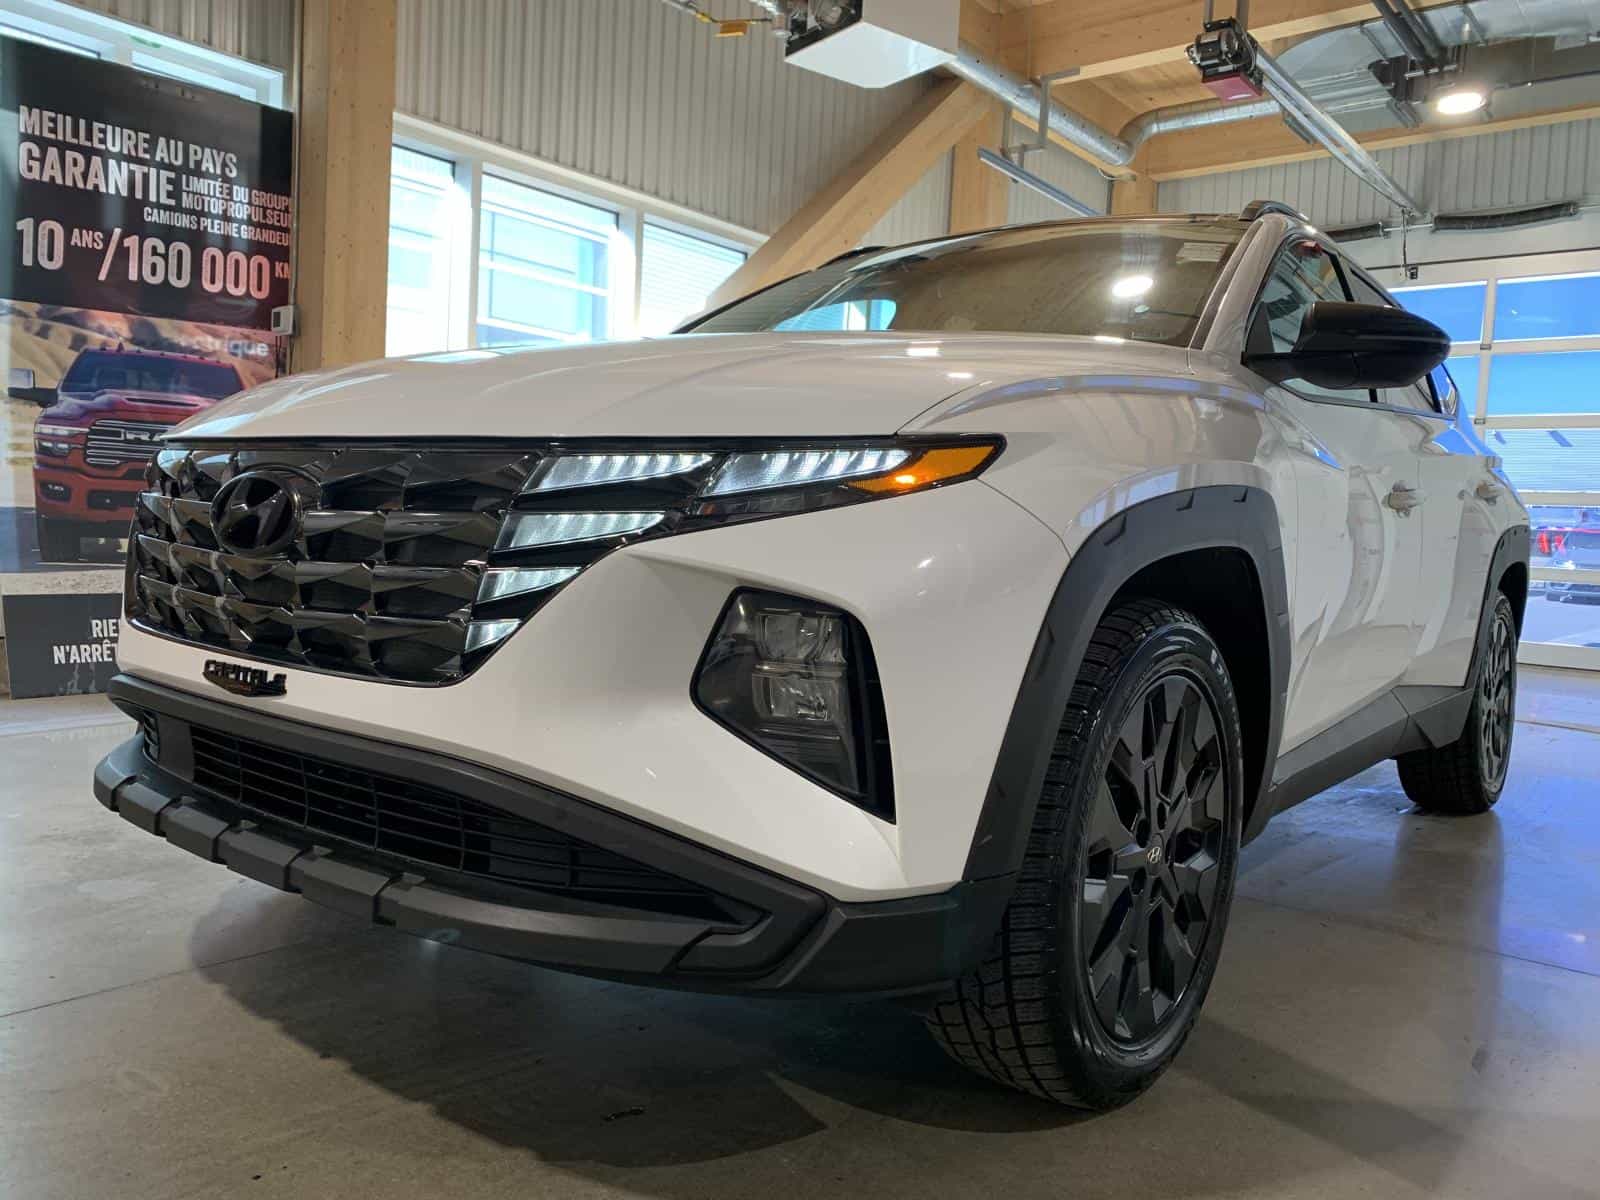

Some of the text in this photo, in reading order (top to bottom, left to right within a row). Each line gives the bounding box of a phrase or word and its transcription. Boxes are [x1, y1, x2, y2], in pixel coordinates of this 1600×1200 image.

[19, 105, 237, 178] MEILLEURE AU PAYS
[19, 141, 176, 206] GARANTIE
[182, 174, 291, 210] LIMITÉE DU GROUP
[143, 207, 289, 246] CAMIONS PLEINE GRANDEU
[15, 218, 64, 270] 10
[202, 247, 270, 299] 000
[91, 618, 120, 638] RIE
